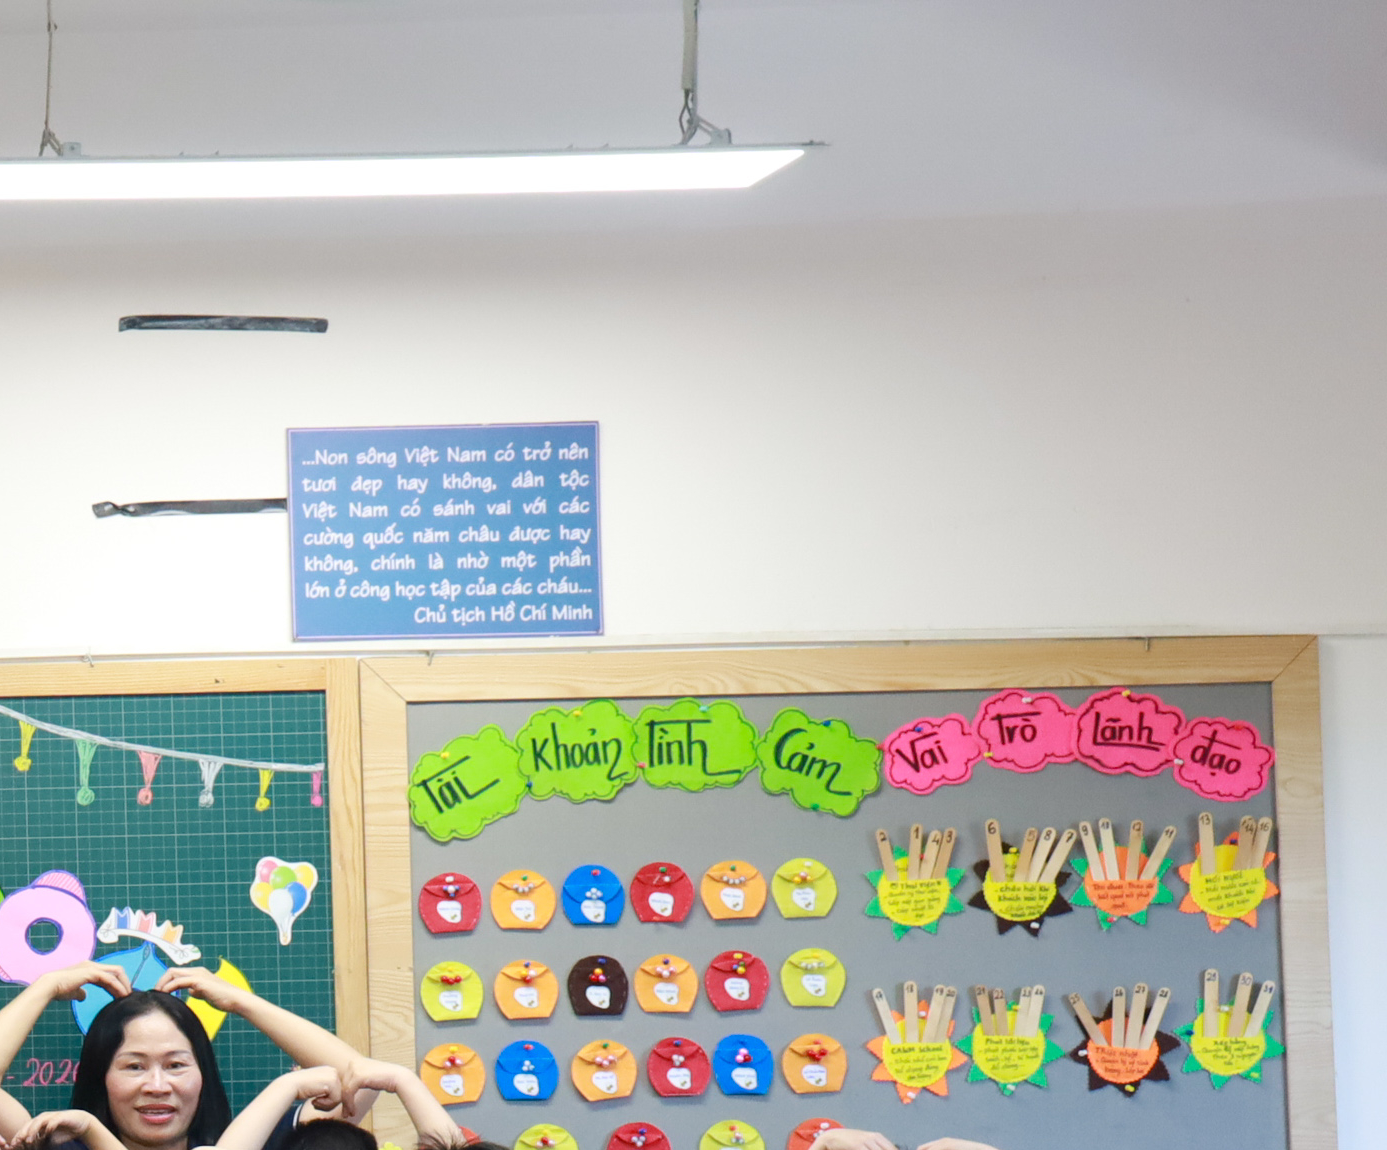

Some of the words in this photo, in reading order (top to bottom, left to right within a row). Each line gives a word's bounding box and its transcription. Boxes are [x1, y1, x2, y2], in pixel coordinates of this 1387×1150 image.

[302, 448, 348, 465] ...Non
[356, 447, 396, 467] sông
[405, 446, 438, 466] Việt
[447, 446, 486, 462] Nam
[495, 442, 514, 461] có
[522, 441, 551, 461] trở
[558, 442, 588, 460] nên
[302, 477, 336, 492] tươi
[351, 476, 382, 496] đẹp
[397, 475, 428, 493] hay
[443, 472, 497, 492] không,
[512, 470, 544, 488] dân
[560, 469, 589, 490] tộc
[303, 502, 337, 522] Việt
[350, 502, 388, 517] Nam
[400, 498, 421, 517] có
[433, 499, 474, 516] sánh
[487, 500, 510, 515] vai
[523, 497, 546, 514] với
[559, 500, 590, 513] các
[304, 527, 354, 549] cường
[363, 523, 403, 549] quốc
[413, 528, 449, 543] năm
[458, 525, 499, 542] châu
[509, 526, 550, 544] được
[560, 525, 591, 543] hay
[305, 554, 358, 575] không,
[371, 552, 415, 570] chính
[429, 553, 443, 569] là
[457, 551, 488, 569] nhờ
[501, 551, 537, 571] một
[549, 546, 591, 573] phần
[305, 580, 329, 598] lớn
[335, 579, 346, 598] ở
[350, 579, 390, 601] công
[395, 581, 425, 600] học
[430, 579, 461, 601] tập
[466, 577, 496, 595] của
[502, 578, 532, 595] các
[537, 576, 592, 594] cháu...
[414, 604, 446, 623] Chủ
[452, 607, 485, 626] tịch
[491, 601, 515, 621] Hồ
[520, 604, 546, 621] Chí
[552, 605, 592, 621] Minh
[895, 732, 948, 773] Vai
[991, 711, 1042, 746] Trò
[1092, 711, 1166, 752] Lãnh
[1190, 731, 1242, 776] đạo
[532, 722, 629, 781] Khoản
[645, 718, 742, 776] Tình
[774, 727, 853, 796] Cảm
[879, 832, 886, 842] 2
[914, 827, 919, 839] 1
[932, 834, 939, 845] 4
[947, 831, 952, 843] 3
[988, 822, 996, 834] 6
[1027, 830, 1035, 841] 5
[1044, 830, 1052, 840] 8
[1082, 825, 1089, 836] 9
